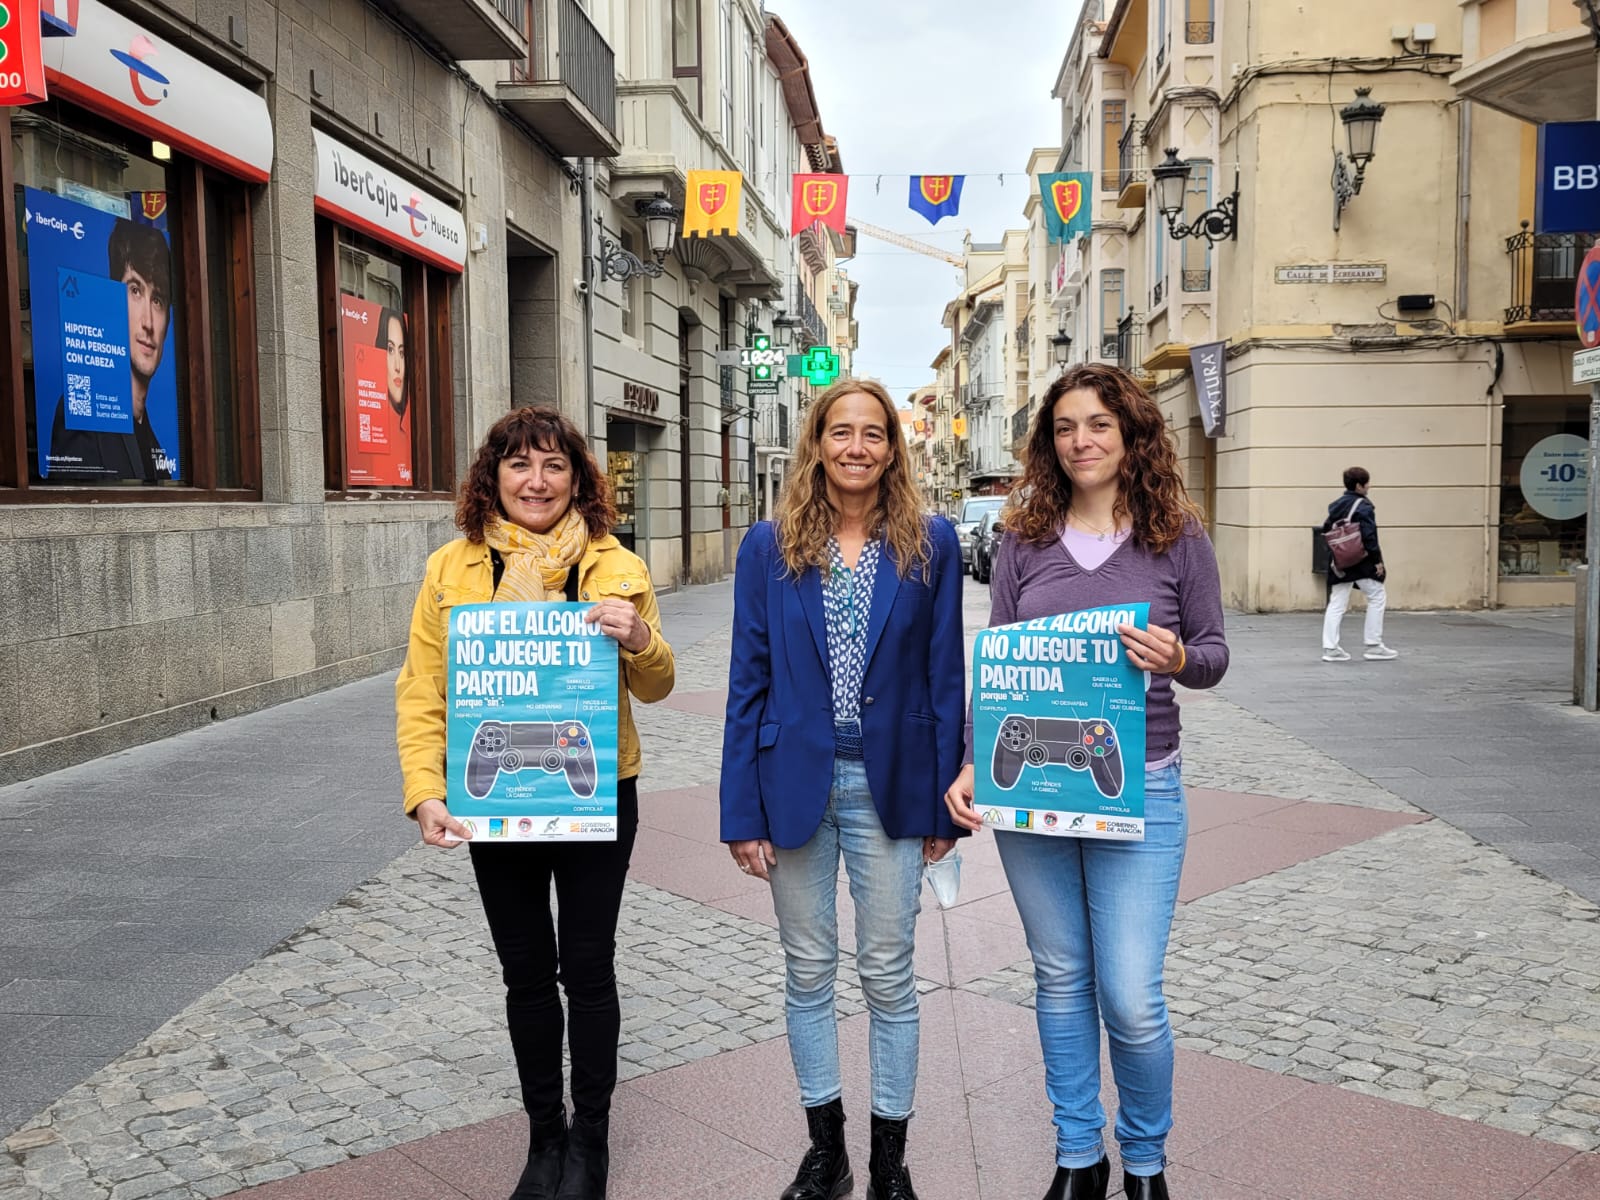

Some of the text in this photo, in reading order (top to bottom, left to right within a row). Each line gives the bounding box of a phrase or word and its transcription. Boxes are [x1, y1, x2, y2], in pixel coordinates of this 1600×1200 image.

[332, 150, 398, 217] iberCaja
[1553, 165, 1600, 190] BB
[35, 212, 68, 233] iberCaja
[431, 214, 459, 244] Huesca
[65, 337, 127, 356] PARA PERSONAS
[66, 352, 115, 369] CON CABEZA
[457, 611, 496, 638] QUE
[500, 611, 522, 635] EL
[456, 640, 591, 666] NO JUEGUE TU
[981, 635, 1118, 664] NO JUEGUE TU
[456, 671, 539, 696] PARTIDA
[980, 664, 1064, 692] PARTIDA
[456, 699, 483, 709] porque
[980, 692, 1008, 702] porque
